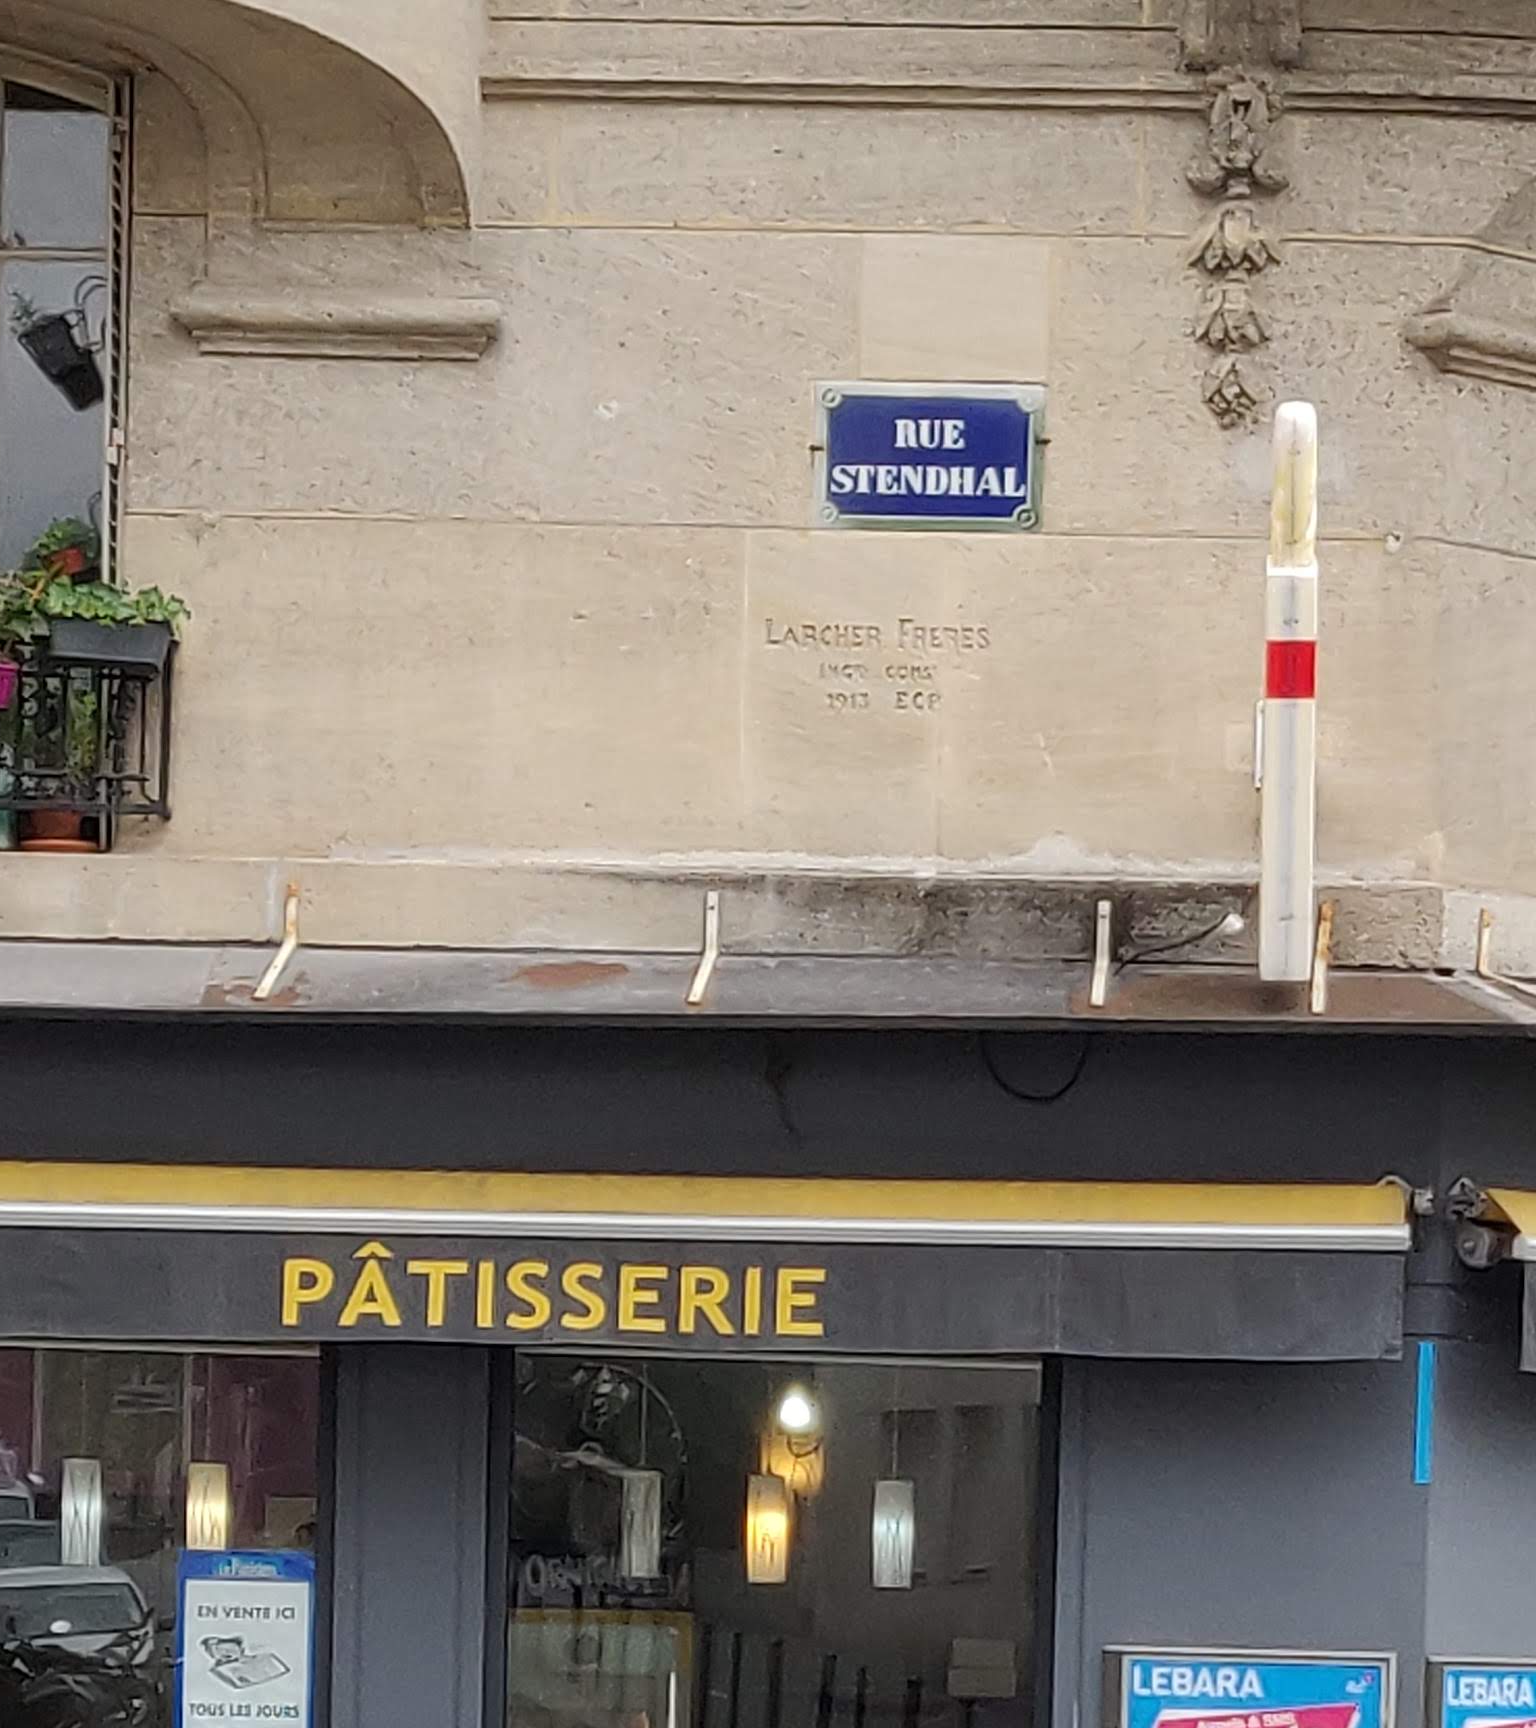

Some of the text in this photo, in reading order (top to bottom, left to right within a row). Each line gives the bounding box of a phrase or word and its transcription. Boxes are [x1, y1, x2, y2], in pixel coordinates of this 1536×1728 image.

[894, 418, 965, 449] RUE
[830, 464, 1026, 497] STENDHAL
[281, 1240, 826, 1338] PÂTISSERIE
[197, 1605, 296, 1620] EN VENTE ICI
[1132, 1665, 1265, 1698] LEBARA
[1446, 1674, 1535, 1708] LEBARA
[189, 1703, 300, 1719] TOUS LES JOURS
